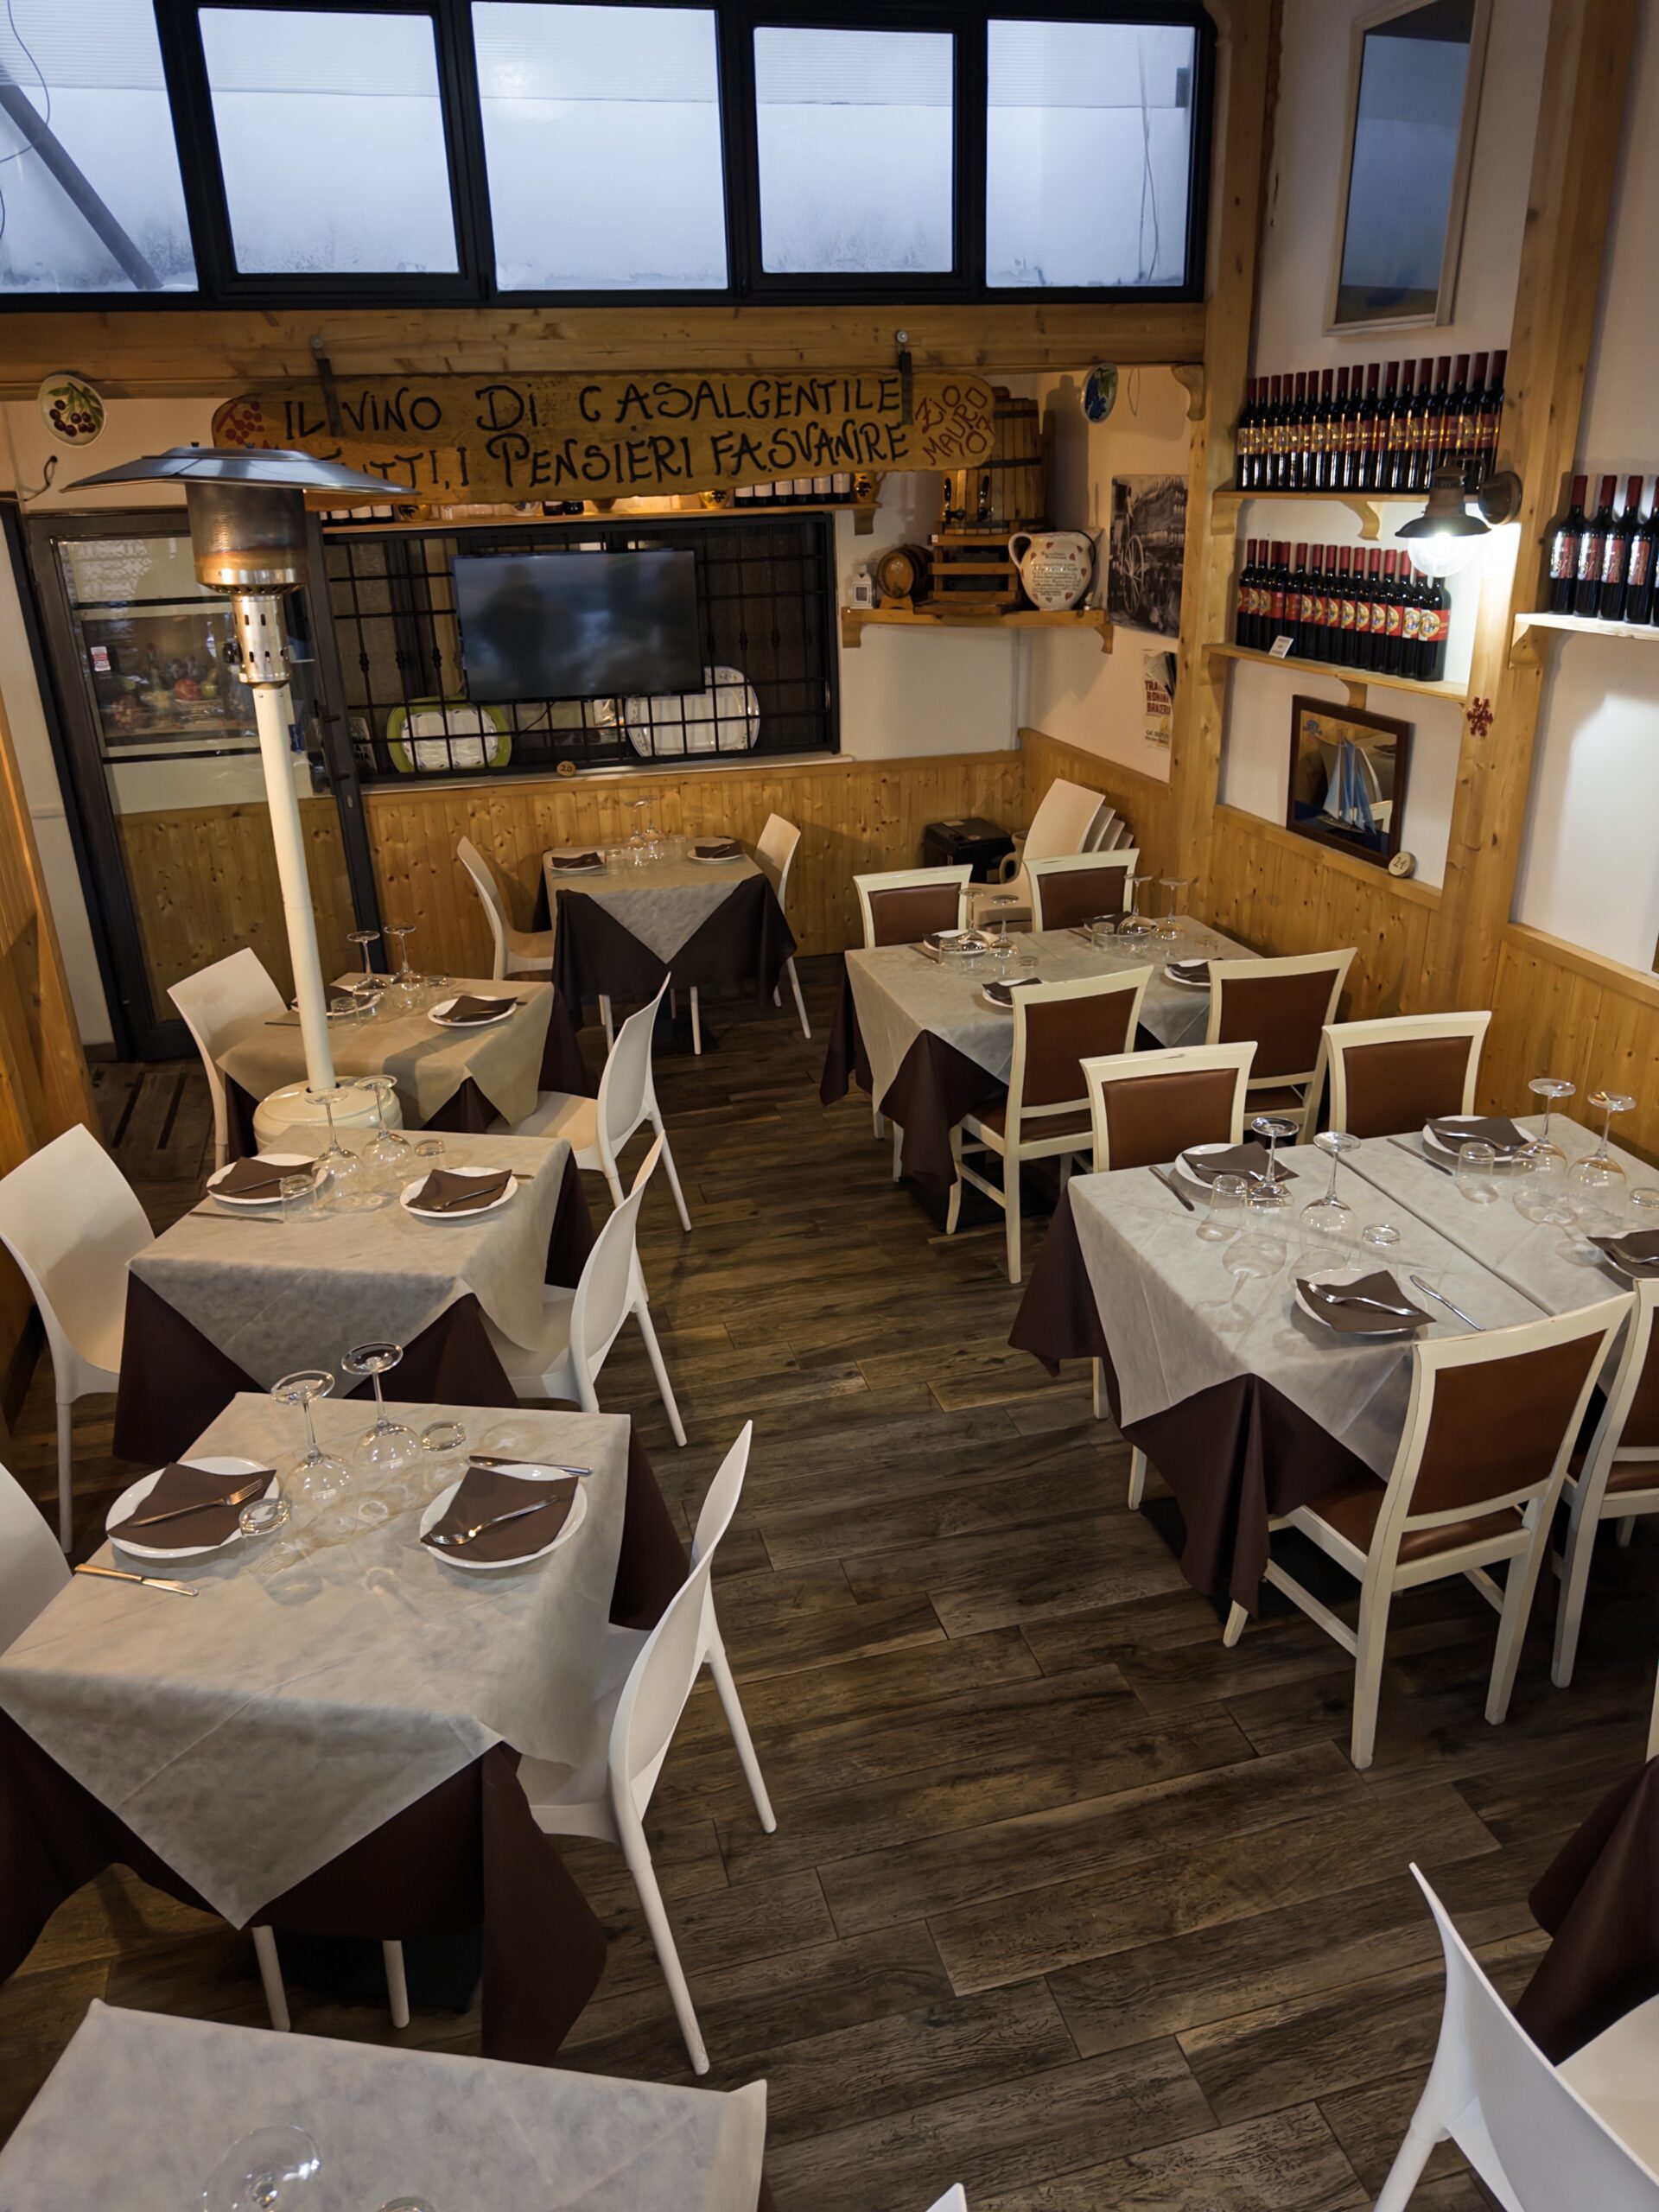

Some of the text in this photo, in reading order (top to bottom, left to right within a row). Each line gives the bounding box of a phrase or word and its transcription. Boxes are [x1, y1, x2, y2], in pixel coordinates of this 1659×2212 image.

[286, 401, 326, 440] IL
[922, 387, 988, 466] MAURO
[486, 433, 693, 487] PENSIERI
